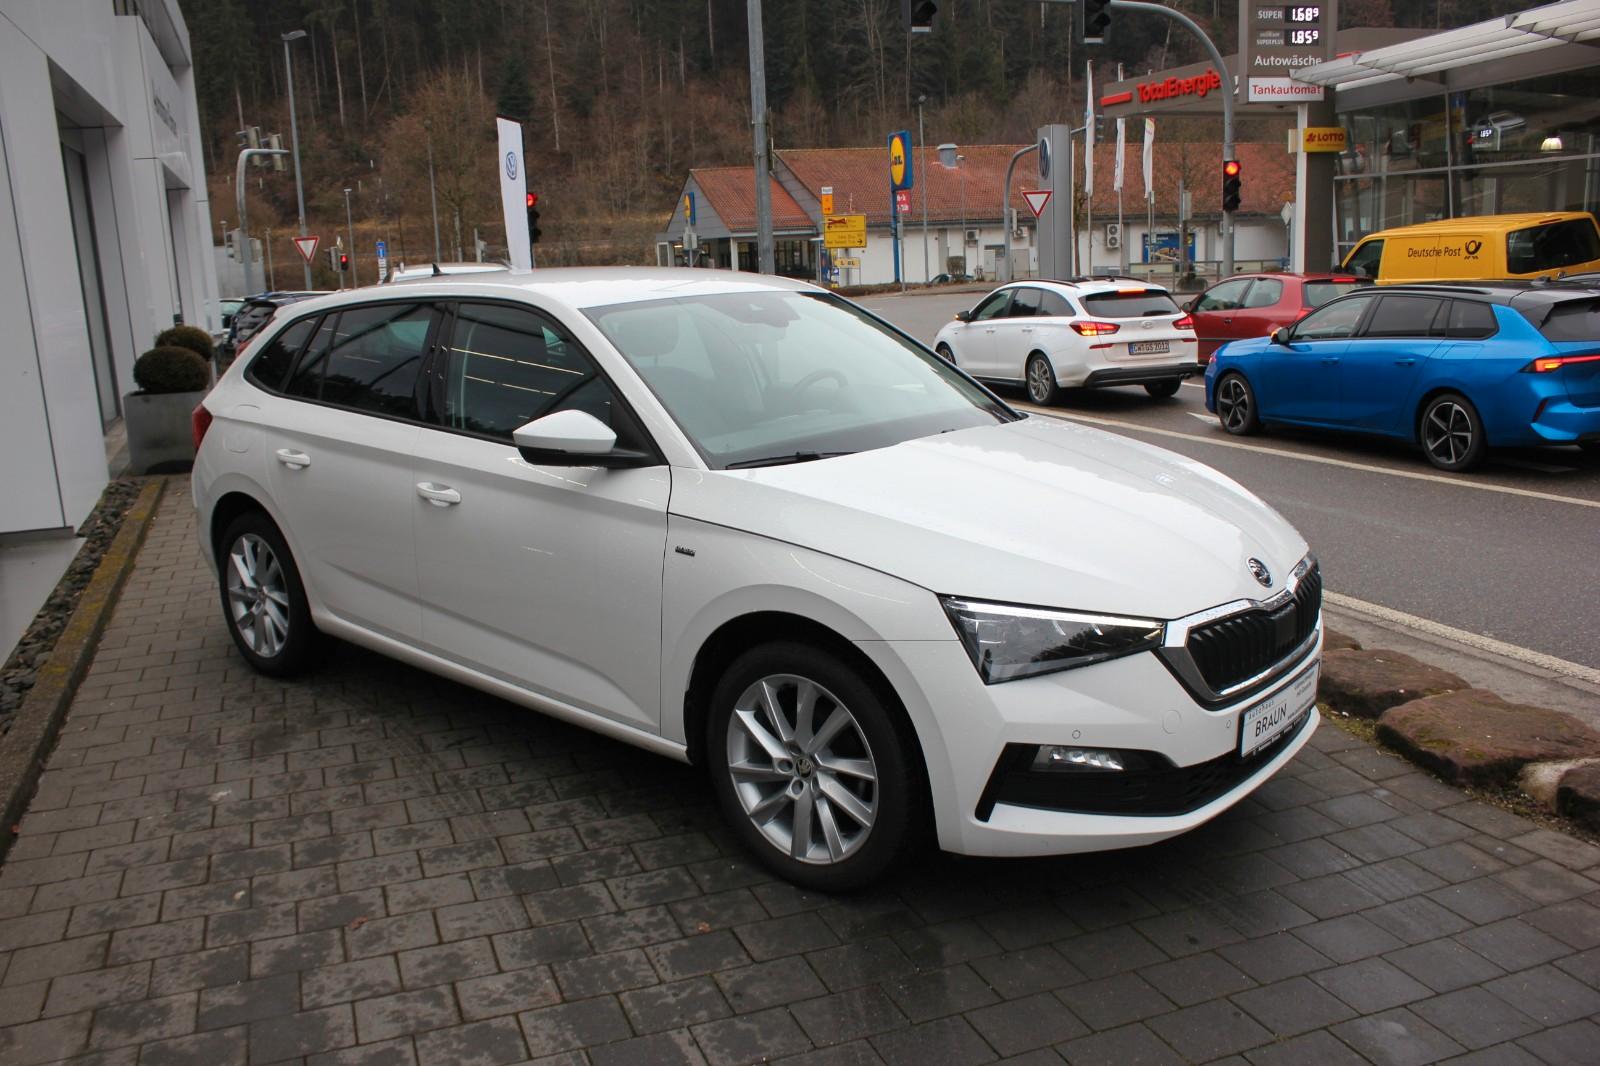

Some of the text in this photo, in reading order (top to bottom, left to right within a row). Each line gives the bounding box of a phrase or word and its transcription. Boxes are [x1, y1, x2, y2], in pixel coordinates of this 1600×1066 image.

[1258, 10, 1282, 19] SUPER
[1254, 54, 1322, 66] Autowäsche
[1137, 67, 1221, 104] TotalEnergie
[1252, 84, 1321, 95] Tankautomat
[1318, 132, 1345, 142] LOTTO
[1407, 246, 1461, 258] Deutsche Post
[1255, 703, 1287, 737] BRAUN
